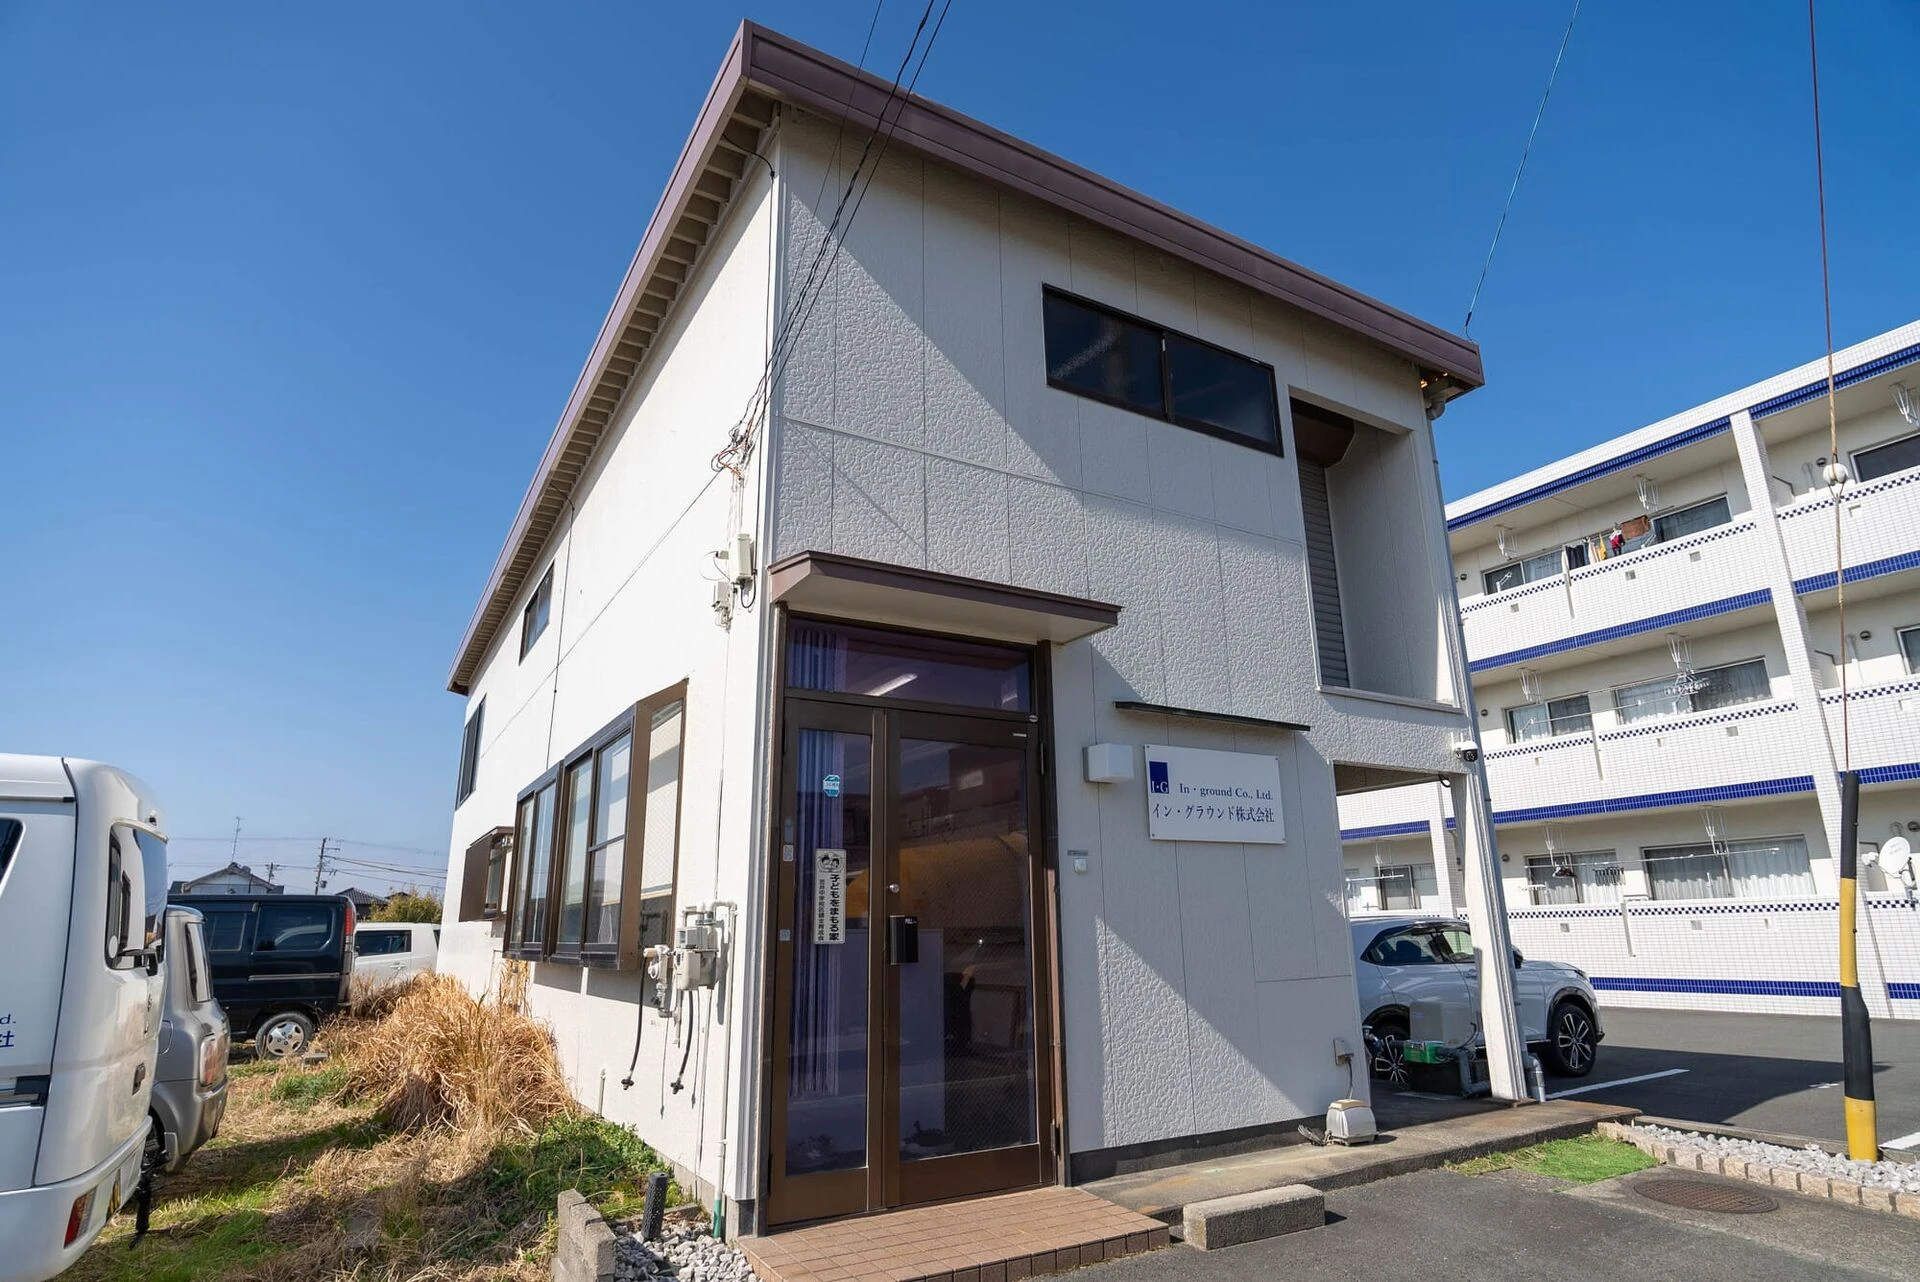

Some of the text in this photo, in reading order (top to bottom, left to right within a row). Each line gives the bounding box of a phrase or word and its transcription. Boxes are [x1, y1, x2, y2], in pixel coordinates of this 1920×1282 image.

[1235, 787, 1253, 800] Co.,
[1256, 789, 1274, 801] Ltd.
[1152, 803, 1275, 823] イン・グラウンド株式会社
[829, 874, 840, 941] 子どもをまもる家
